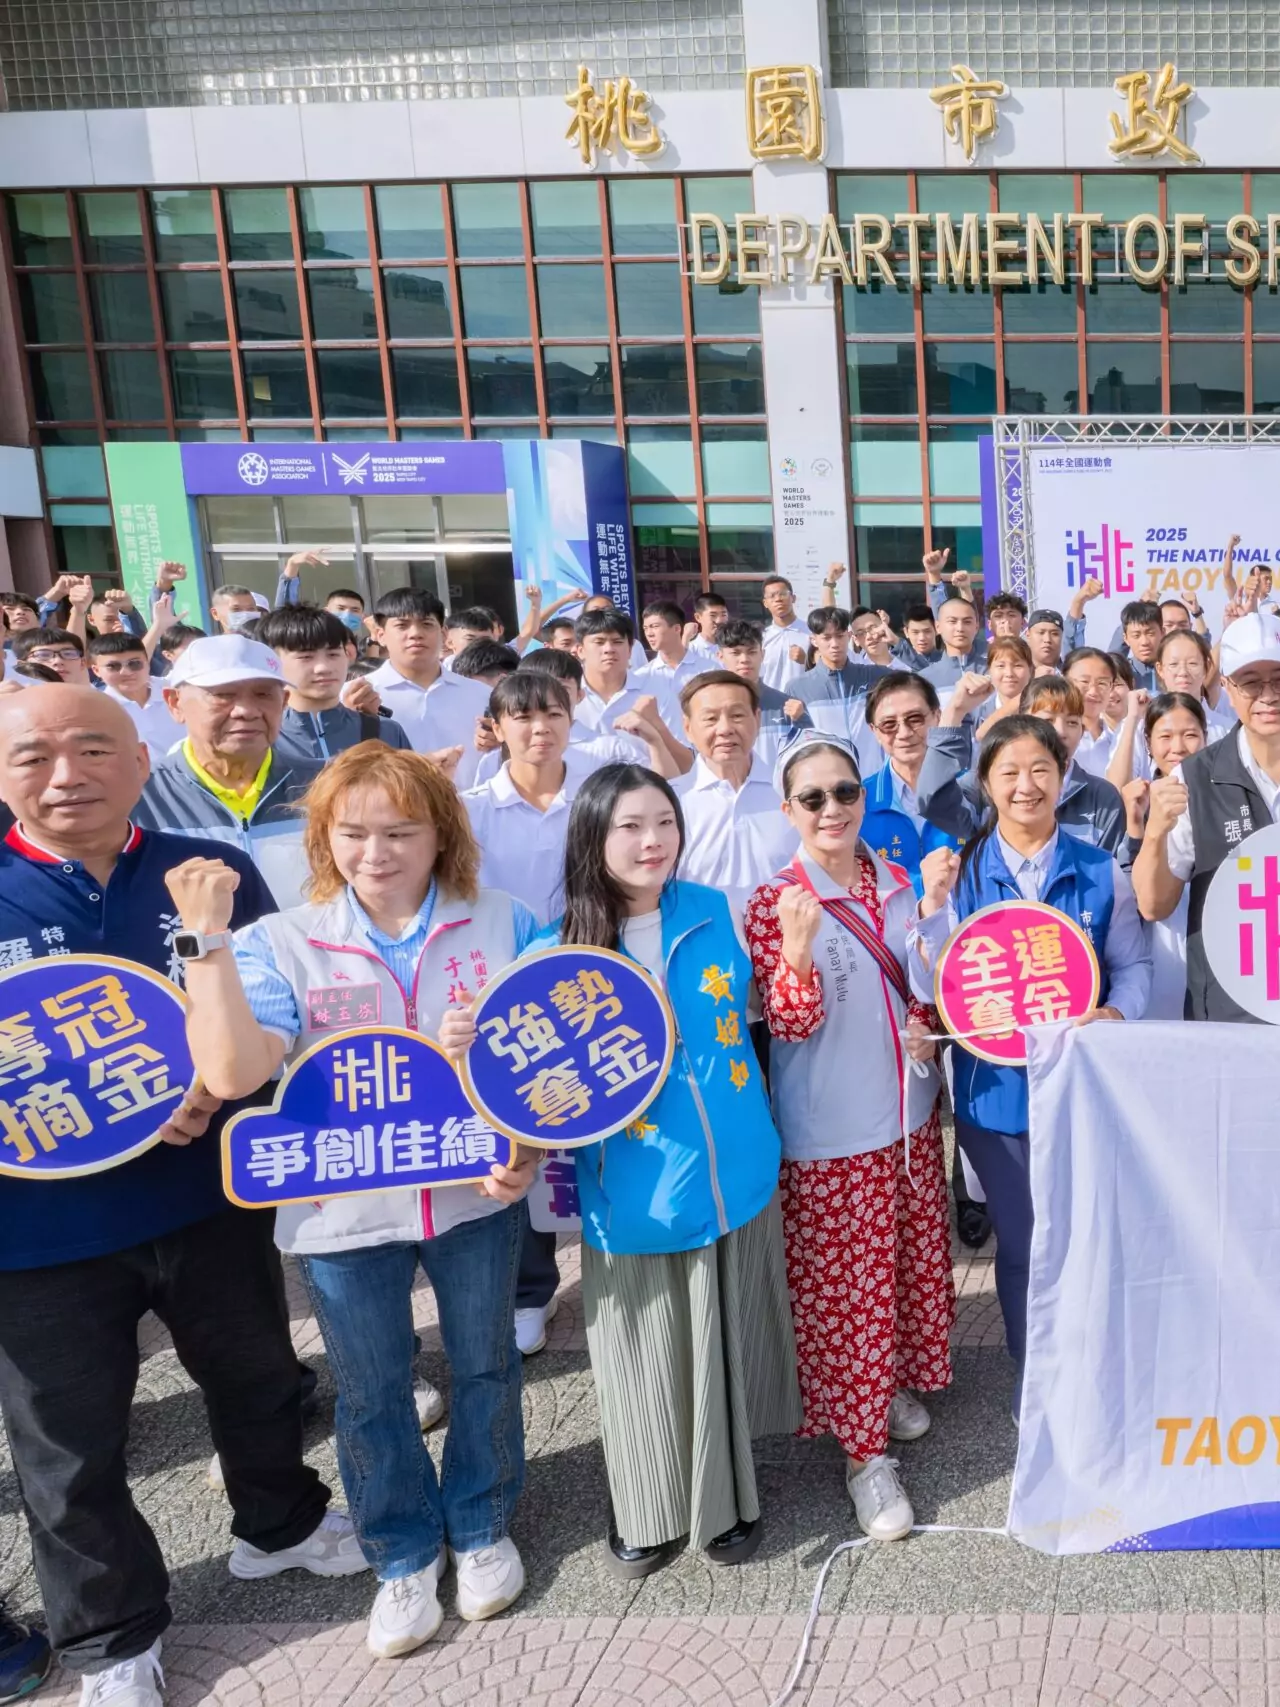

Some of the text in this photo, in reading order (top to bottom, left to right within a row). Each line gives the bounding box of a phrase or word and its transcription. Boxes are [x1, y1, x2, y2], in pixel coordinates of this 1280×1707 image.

[691, 211, 1105, 286] DEPARTMENT
[1124, 212, 1208, 286] OF
[371, 456, 446, 465] WORLD MASTERS GAMES
[373, 473, 396, 482] 2025
[606, 523, 617, 555] LIFE
[784, 518, 805, 526] 2025
[1145, 527, 1188, 542] 2025
[615, 524, 628, 580] SPORTS
[1147, 549, 1179, 563] THE
[1240, 804, 1253, 832] 市長
[825, 937, 849, 1003] Panay Mulu
[957, 923, 1068, 991] 全運
[477, 969, 625, 1076] 強勢
[515, 1023, 661, 1128] 奪金
[246, 1115, 499, 1189] 爭創佳績
